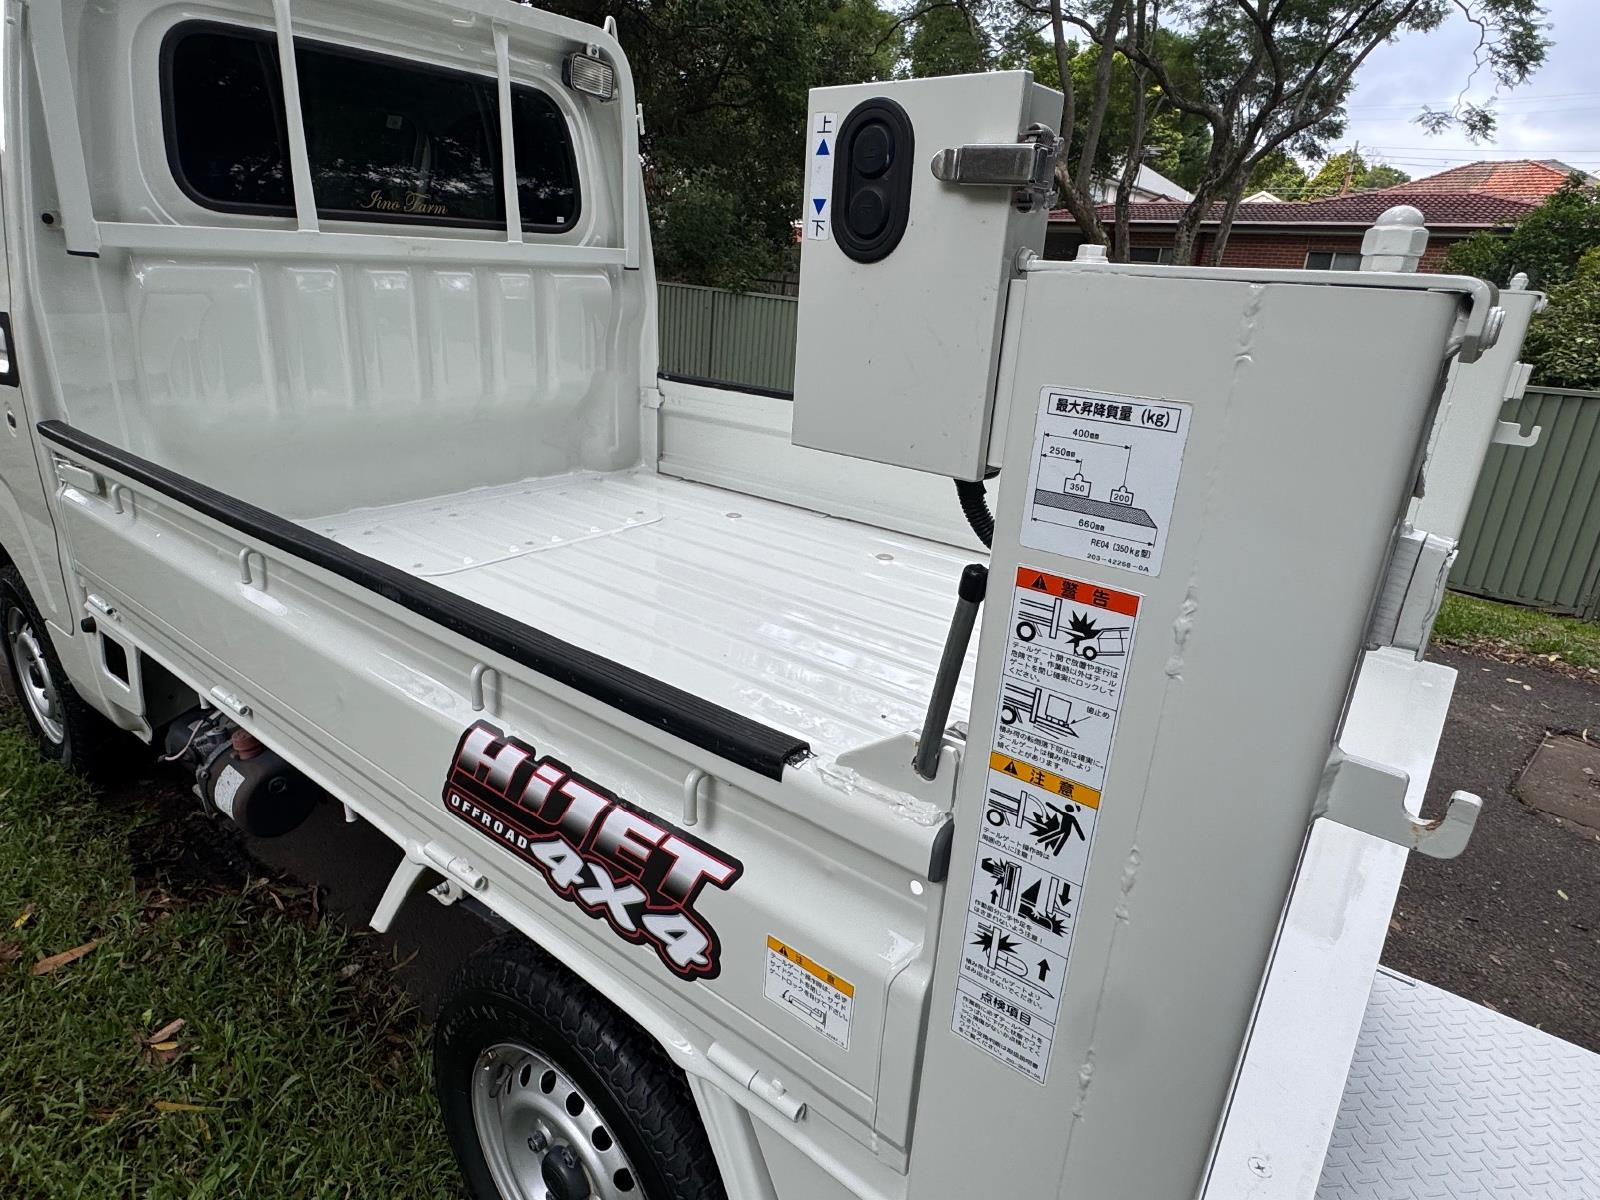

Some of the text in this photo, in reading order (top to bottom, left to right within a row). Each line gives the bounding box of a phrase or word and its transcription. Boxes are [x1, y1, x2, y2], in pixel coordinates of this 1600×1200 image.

[816, 116, 832, 133] 上
[403, 190, 448, 215] Farm
[812, 220, 826, 237] 下
[1055, 398, 1133, 422] 最大昇降質量
[1069, 482, 1085, 492] 350
[1113, 493, 1130, 503] 200
[451, 794, 528, 850] OFFROAD
[980, 992, 1032, 1026] 点検項目
